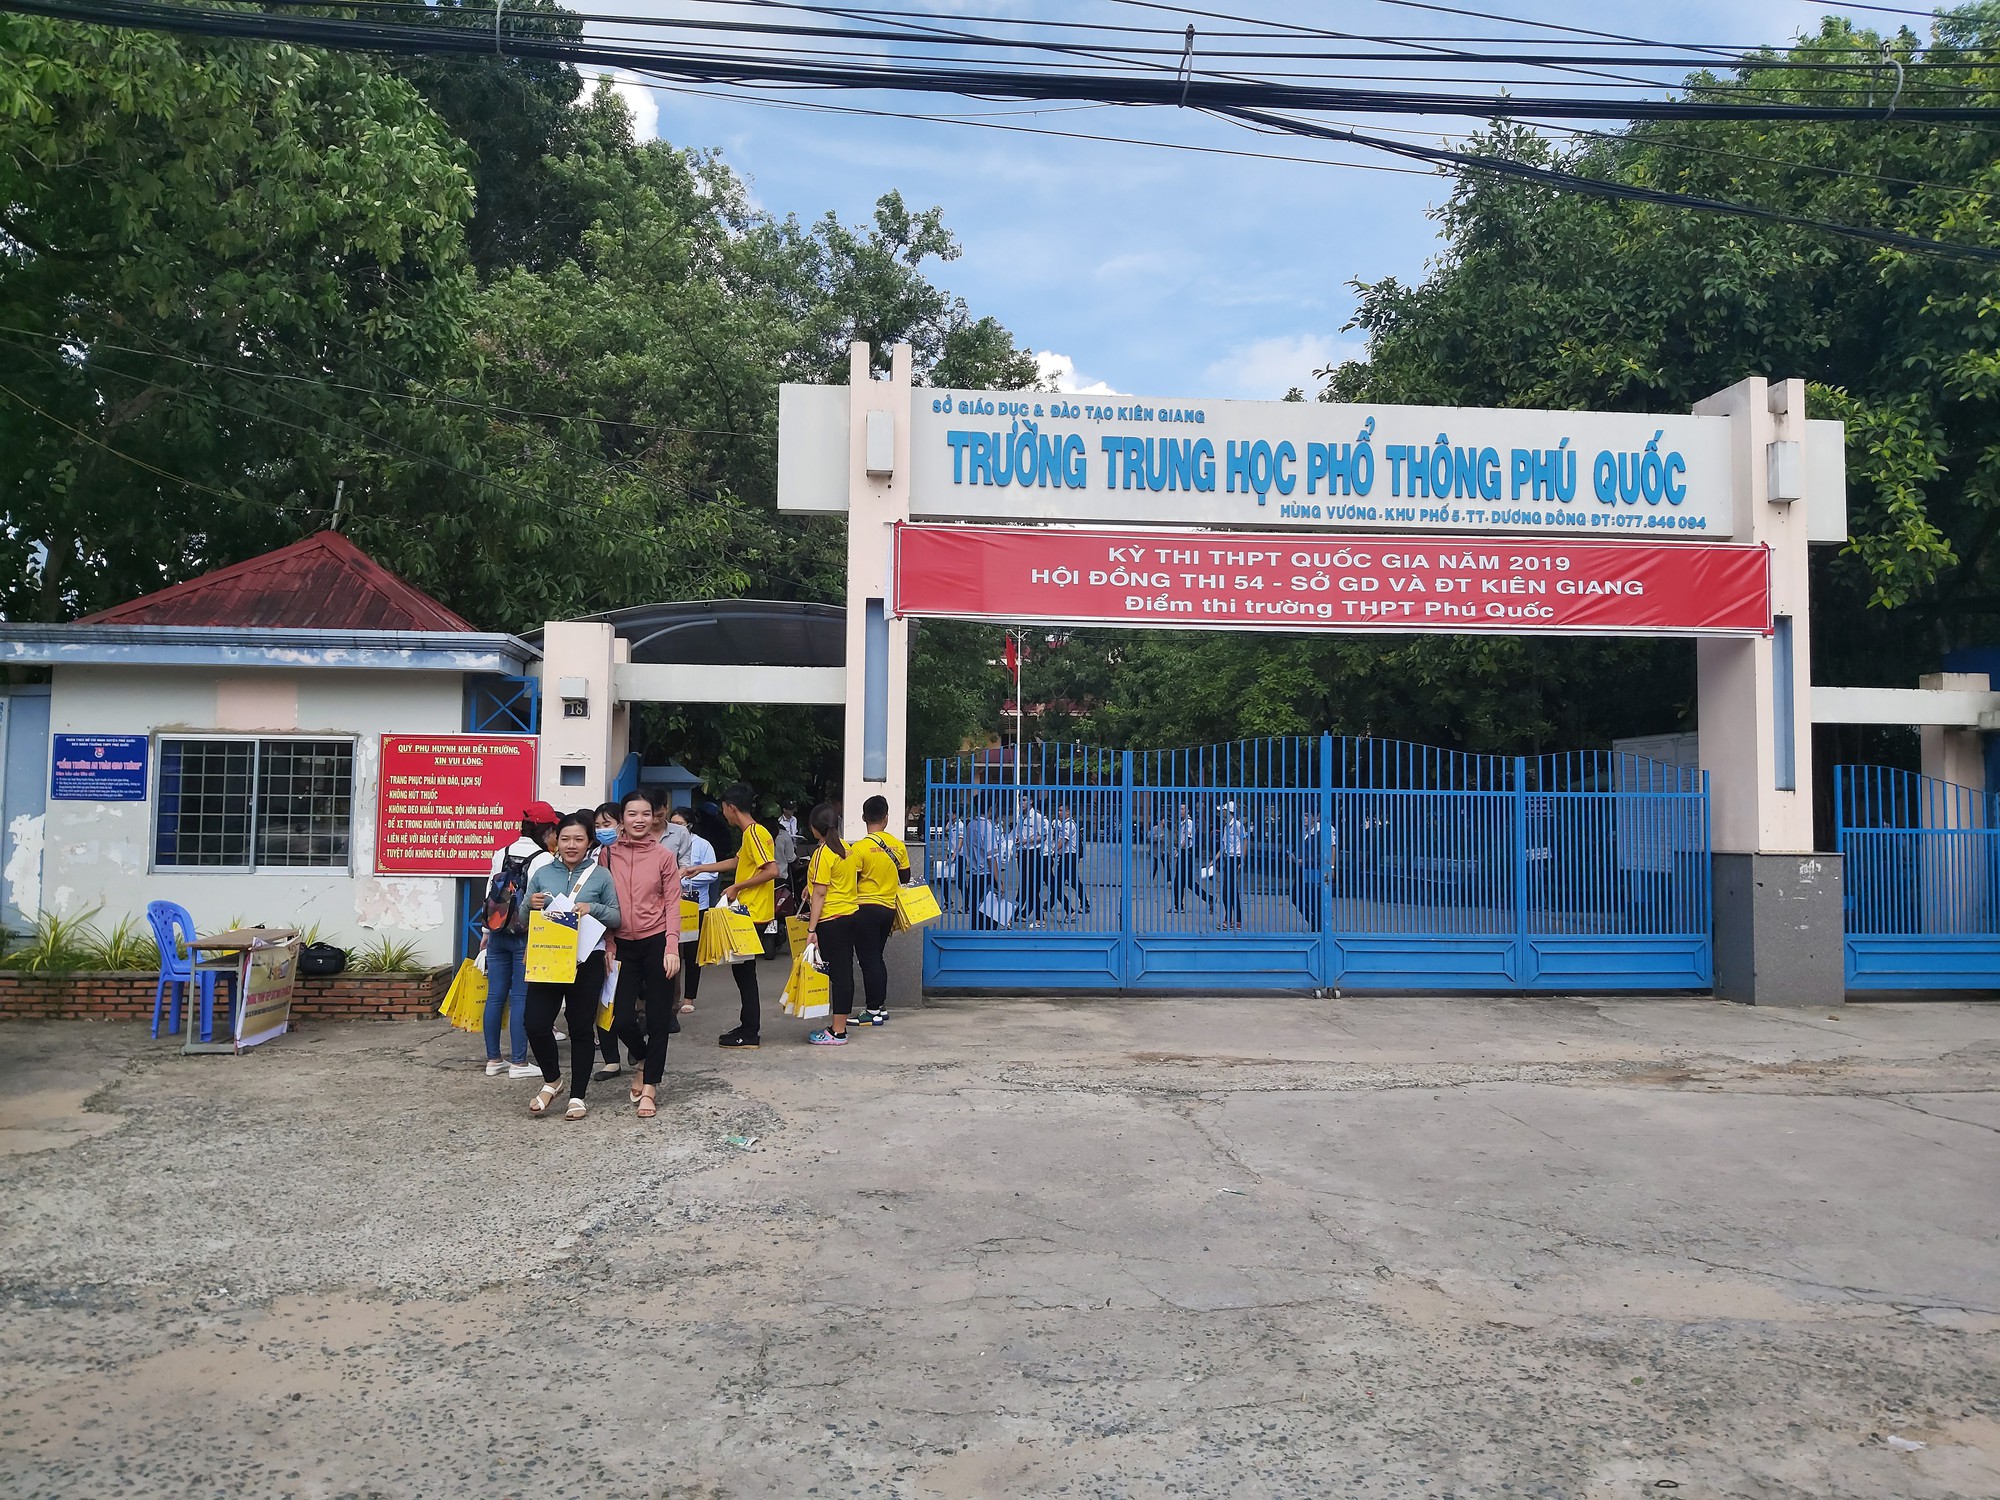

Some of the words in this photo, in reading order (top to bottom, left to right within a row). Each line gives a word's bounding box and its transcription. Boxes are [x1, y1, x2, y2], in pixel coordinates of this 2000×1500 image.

[932, 394, 953, 414] SỞ
[958, 397, 994, 415] GIÁO
[998, 402, 1029, 421] DỤC
[1034, 404, 1044, 416] &
[1050, 401, 1080, 419] ĐÀO
[1085, 405, 1114, 424] TẠO
[1117, 405, 1154, 422] KIÊN
[1158, 407, 1206, 424] GIANG
[947, 418, 1088, 489] TRƯỜNG
[1101, 435, 1216, 492] TRUNG
[1226, 439, 1297, 506] HỌC
[1307, 416, 1376, 496] PHỔ
[1386, 433, 1500, 502] THÔNG
[1511, 437, 1577, 502] PHÚ
[1593, 429, 1687, 507] QUỐC
[1280, 500, 1321, 519] HÙNG
[1420, 503, 1449, 522] PHỐ
[1545, 509, 1586, 526] ĐÔNG
[1109, 544, 1146, 564] KỲ
[1154, 549, 1199, 565] THI
[1208, 550, 1282, 567] THPT
[1291, 547, 1372, 569] QUỐC
[1381, 552, 1430, 569] GIA
[1439, 551, 1500, 570] NĂM
[1509, 555, 1571, 571] 2019
[1030, 566, 1079, 588] HỘI
[1088, 566, 1171, 588] ĐỒNG
[1180, 573, 1225, 589] THI
[1233, 574, 1265, 590] 54
[1290, 571, 1330, 592] SỞ
[1338, 576, 1379, 592] GD
[1389, 573, 1427, 593] VÀ
[1435, 578, 1472, 593] ĐT
[1481, 575, 1546, 595] KIÊN
[1556, 579, 1645, 595] GIANG
[1125, 593, 1193, 613] Điểm
[1201, 598, 1236, 614] thi
[1245, 596, 1333, 619] trường
[1341, 600, 1415, 617] THPT
[1425, 601, 1476, 618] Phú
[1485, 601, 1554, 619] Quốc
[570, 703, 582, 715] 18
[415, 745, 429, 754] PHỤ
[458, 745, 471, 753] KHI
[473, 743, 487, 753] ĐẾN
